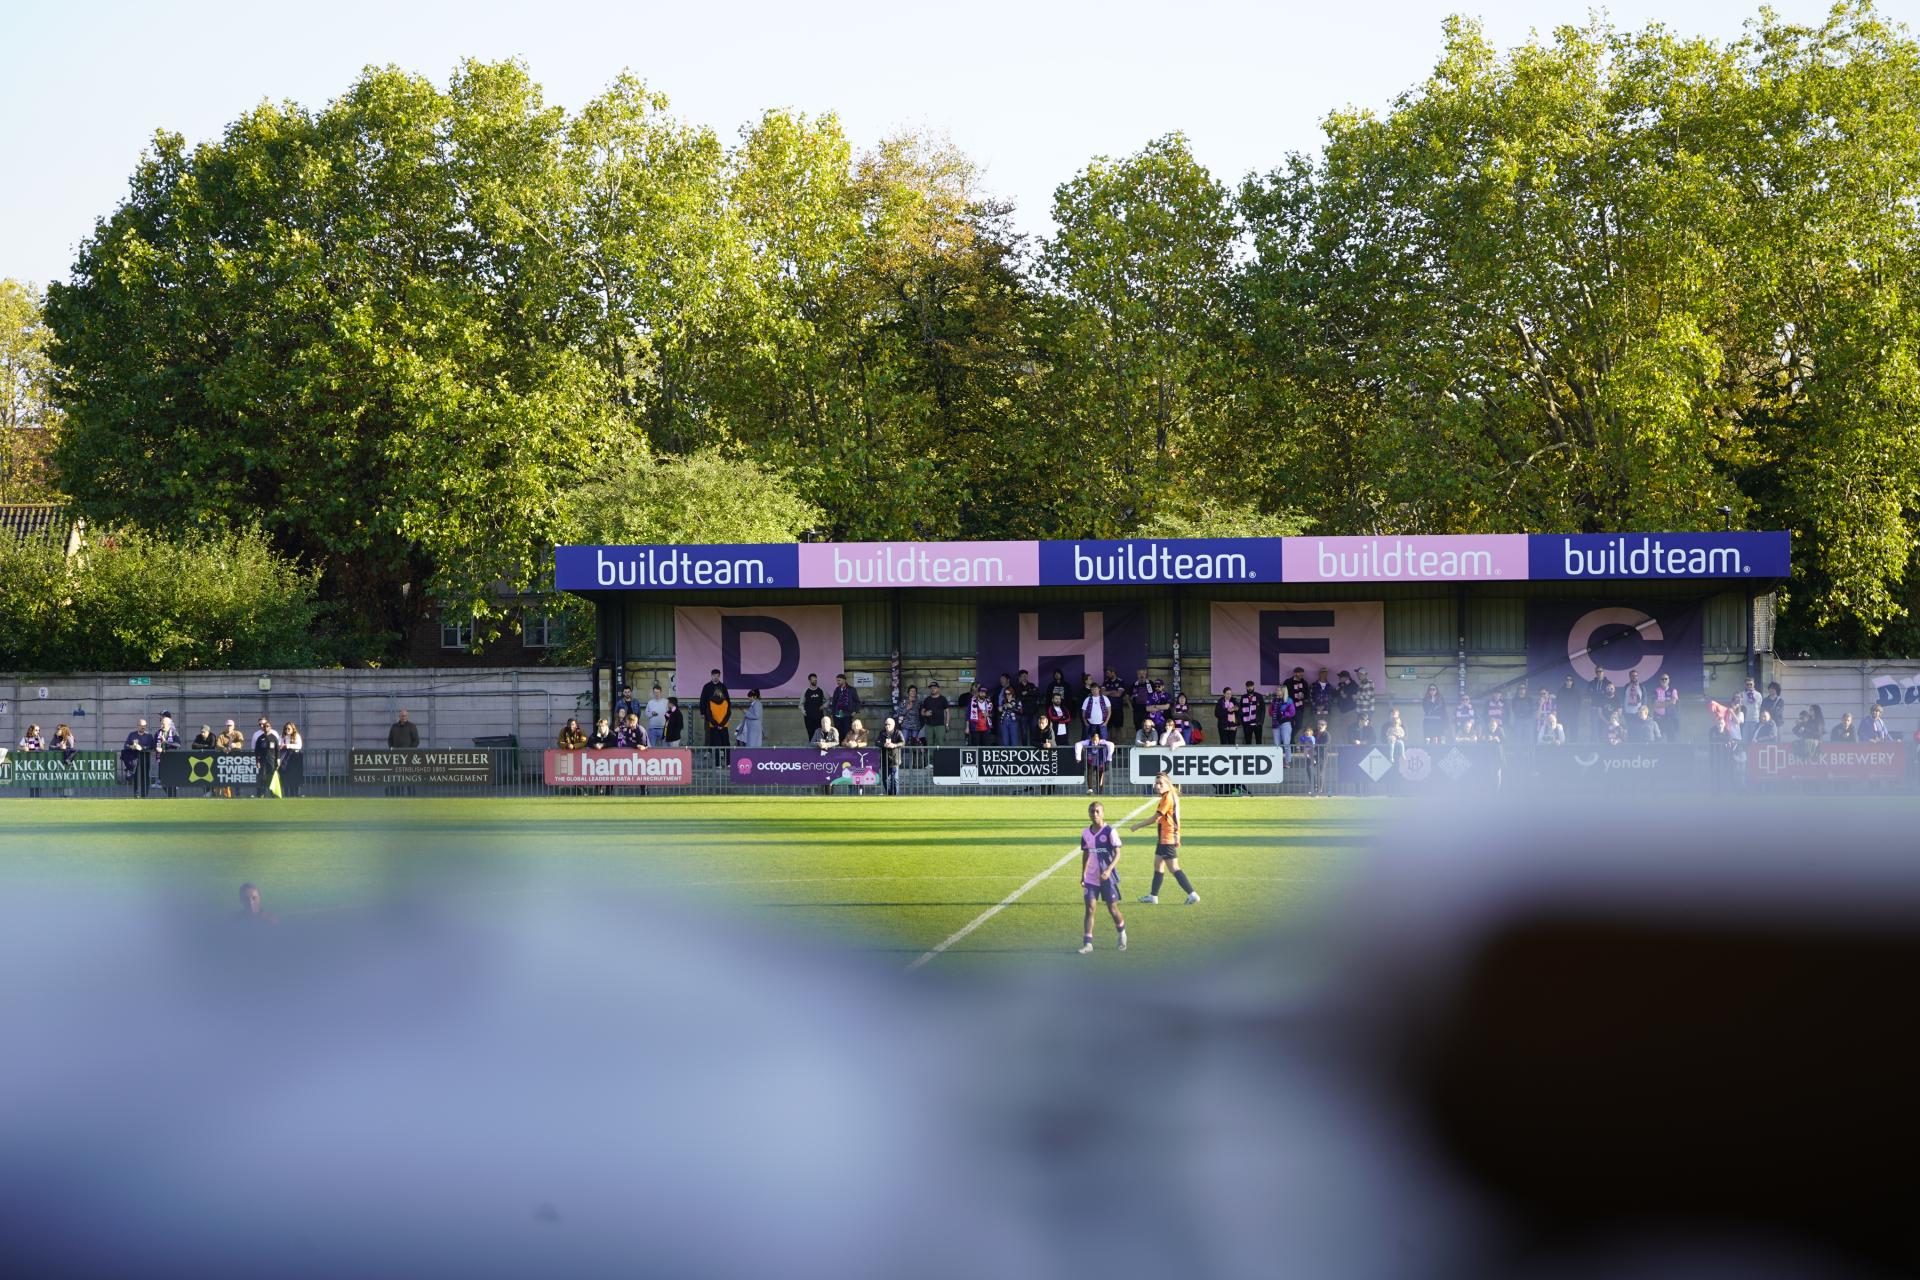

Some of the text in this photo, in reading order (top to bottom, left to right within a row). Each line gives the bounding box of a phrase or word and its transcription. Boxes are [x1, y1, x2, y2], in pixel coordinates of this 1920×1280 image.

[1074, 543, 1246, 581] buildteam
[1318, 540, 1492, 578] buildteam
[1564, 537, 1741, 575] buildteam
[598, 549, 764, 585] buildteam
[834, 546, 1003, 583] buildteam
[721, 615, 800, 690] D
[1019, 611, 1104, 687] H
[1259, 610, 1335, 686] F
[1567, 607, 1664, 688] C
[217, 756, 256, 765] CROSS
[354, 753, 489, 765] HARVEY & WHEELER
[965, 752, 973, 764] B
[982, 749, 1050, 762] BESPOKE
[1831, 752, 1896, 765] BREWERY
[15, 760, 115, 771] KICK ON AT THE
[217, 765, 260, 774] TWENT
[582, 752, 682, 776] harnham
[757, 760, 839, 774] octopus energy
[982, 764, 1050, 776] WINDOWS
[1160, 754, 1273, 776] DEFECTED
[1603, 755, 1658, 773] yonder
[15, 772, 115, 781] EAST DULWICH TAVERN
[217, 774, 256, 783] THREE
[354, 775, 376, 783] SALES
[429, 774, 489, 782] MANAGEMENT
